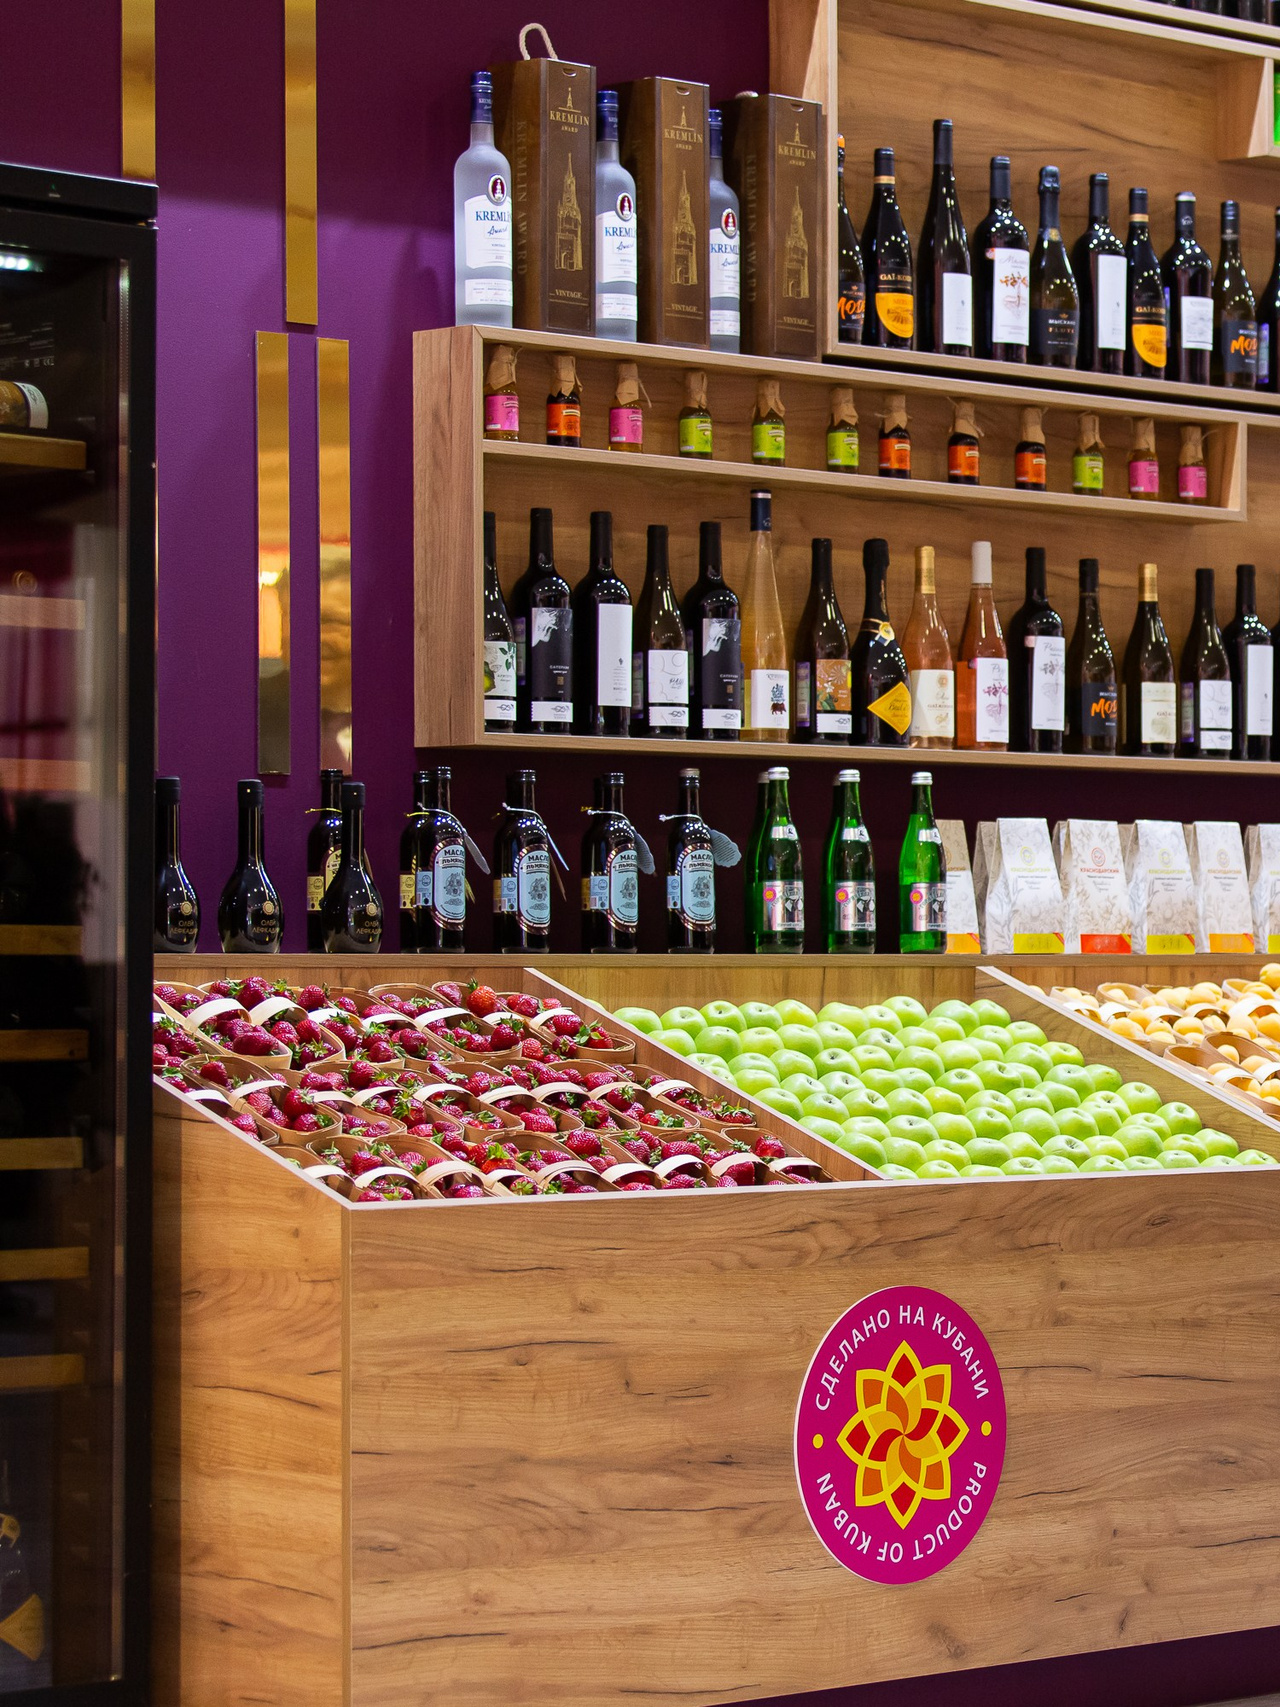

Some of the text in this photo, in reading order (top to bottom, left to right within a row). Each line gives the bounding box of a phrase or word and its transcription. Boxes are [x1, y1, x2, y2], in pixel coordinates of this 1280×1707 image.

[550, 110, 589, 126] KREMLIN
[561, 125, 578, 133] AWARD
[664, 128, 703, 144] KREMLIN
[778, 145, 816, 159] KREMLIN
[516, 121, 528, 275] KREMLIN AWARD
[475, 211, 511, 222] KREMLI
[604, 226, 635, 238] KREML
[555, 288, 583, 299] VINTAGE
[815, 1305, 990, 1411] СДЕЛАНО НА КУБАНИ
[816, 1461, 988, 1563] PRODUCT OF KUBAN
